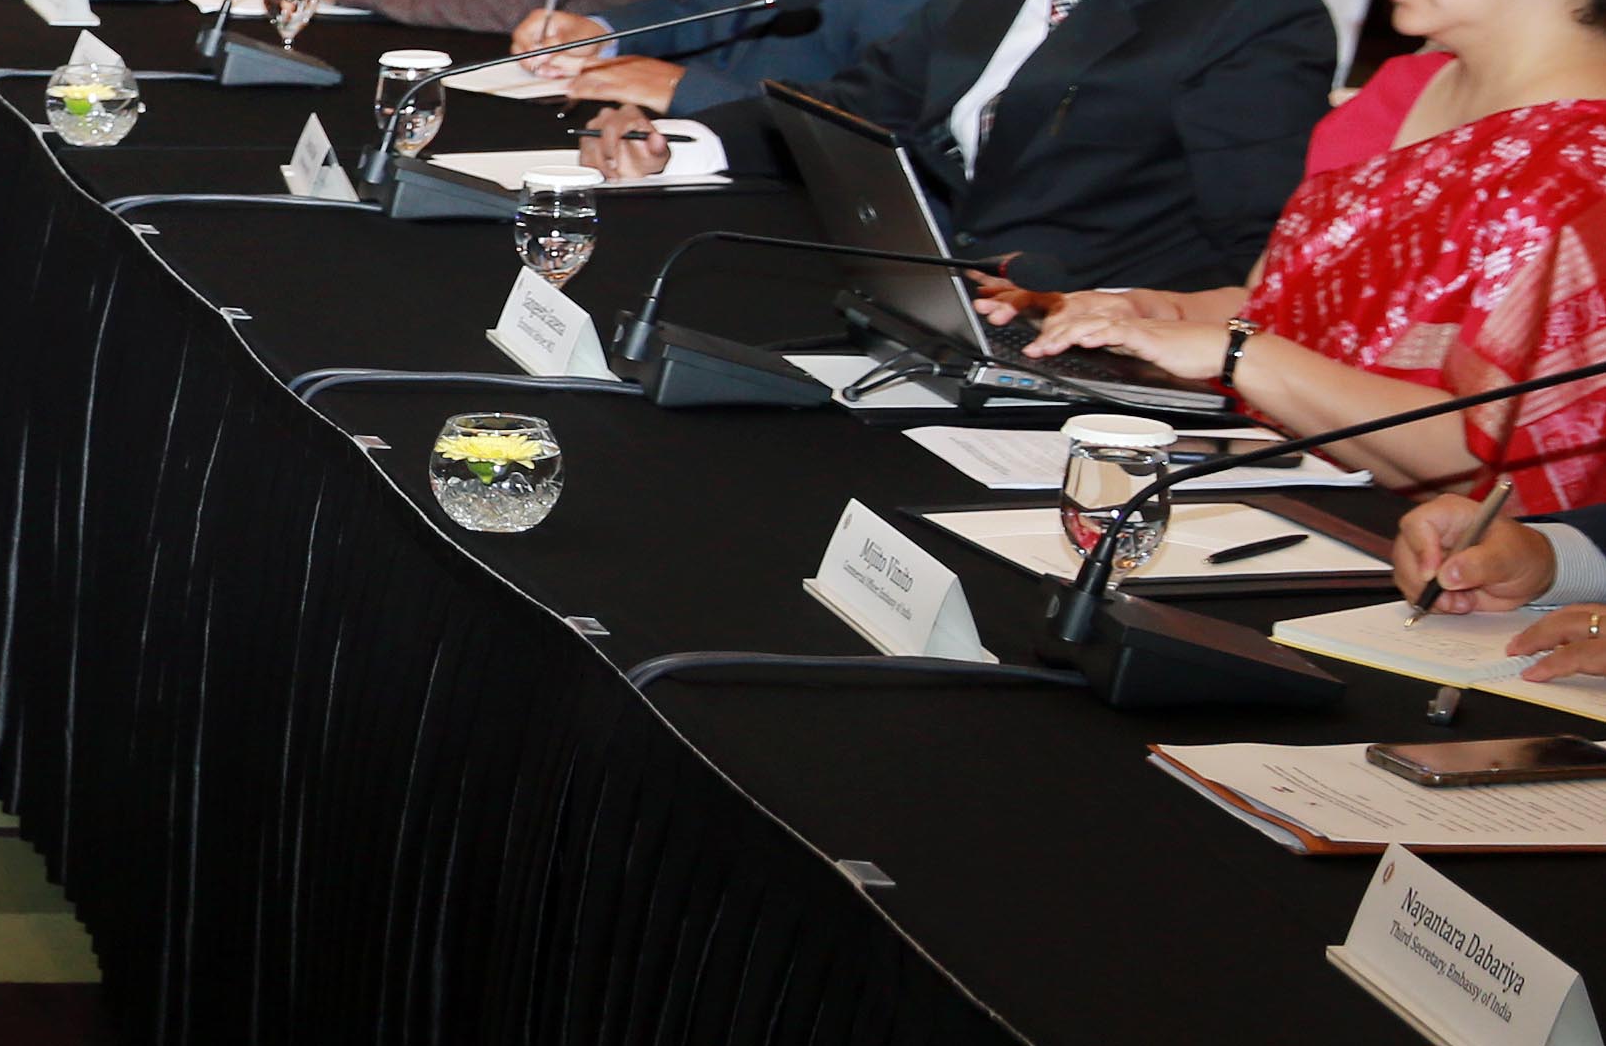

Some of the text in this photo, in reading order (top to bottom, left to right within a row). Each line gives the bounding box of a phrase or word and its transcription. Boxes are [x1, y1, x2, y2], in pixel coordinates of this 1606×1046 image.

[1389, 919, 1514, 1024] Third Secretary, Embassy of India
[1401, 886, 1526, 996] Nayantara Dabariya
